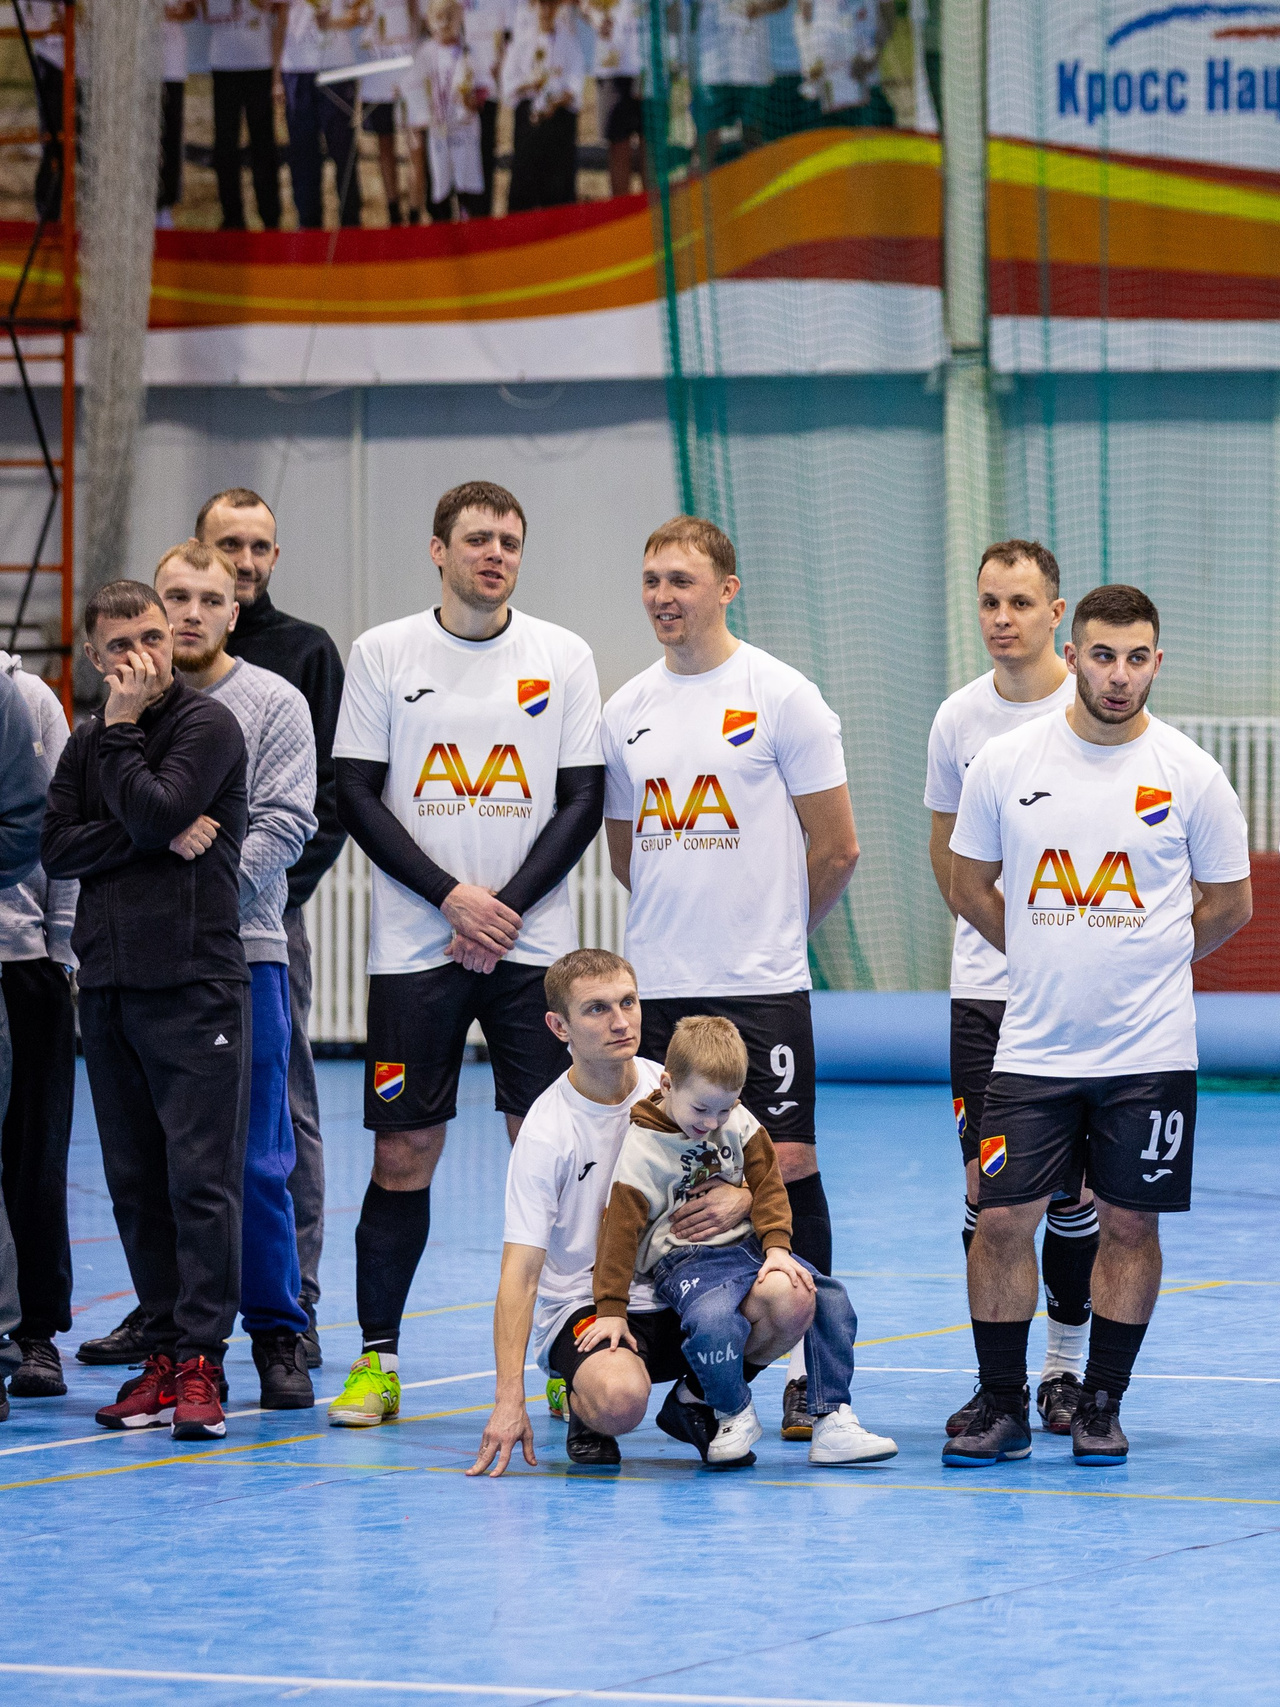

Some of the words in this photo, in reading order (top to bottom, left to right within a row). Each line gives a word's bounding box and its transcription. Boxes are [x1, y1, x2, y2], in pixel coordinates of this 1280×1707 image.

[1057, 59, 1187, 125] Кросс
[413, 743, 532, 798] AVA
[418, 803, 466, 817] GROUP
[478, 804, 533, 819] COMPANY
[636, 774, 740, 833] AVA
[683, 837, 741, 851] COMPANY
[1027, 848, 1146, 909] AVA
[1031, 912, 1075, 927] GROUP
[770, 1043, 795, 1093] 9
[1140, 1109, 1184, 1161] 19
[680, 1140, 708, 1184] READY
